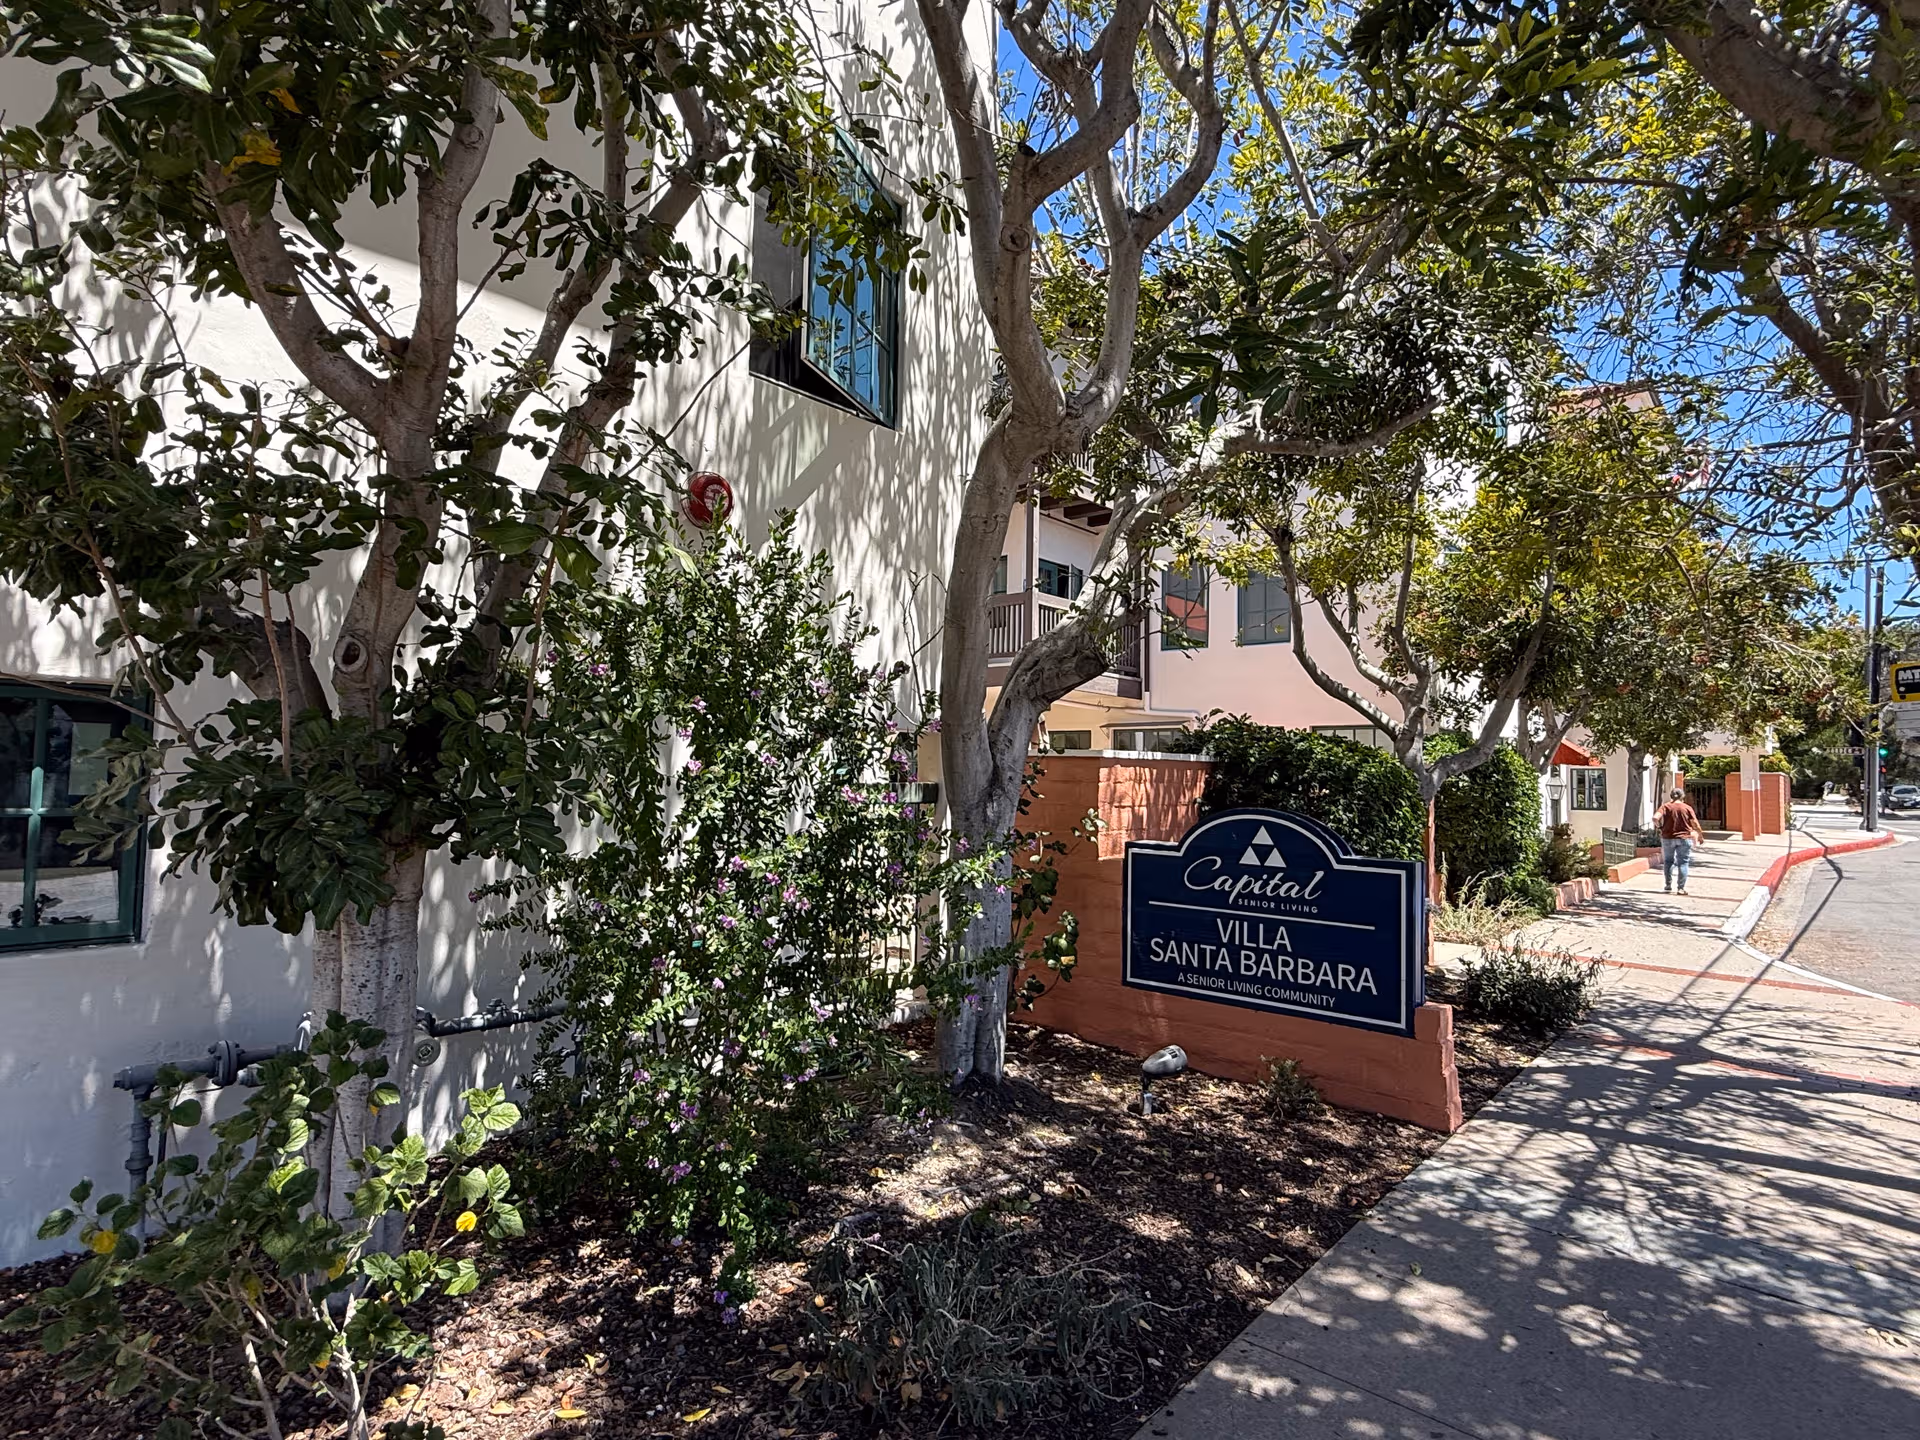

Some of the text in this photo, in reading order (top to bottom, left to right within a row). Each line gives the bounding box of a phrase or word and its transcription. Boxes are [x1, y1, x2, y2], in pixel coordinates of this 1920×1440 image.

[1184, 856, 1324, 904] Capital
[1238, 898, 1318, 914] SENIOR LIVING
[1217, 918, 1292, 952] VILLA
[1150, 937, 1378, 995] SANTA BARBARA
[1178, 972, 1336, 1008] A SENIOR LIVING COMMUNITY
